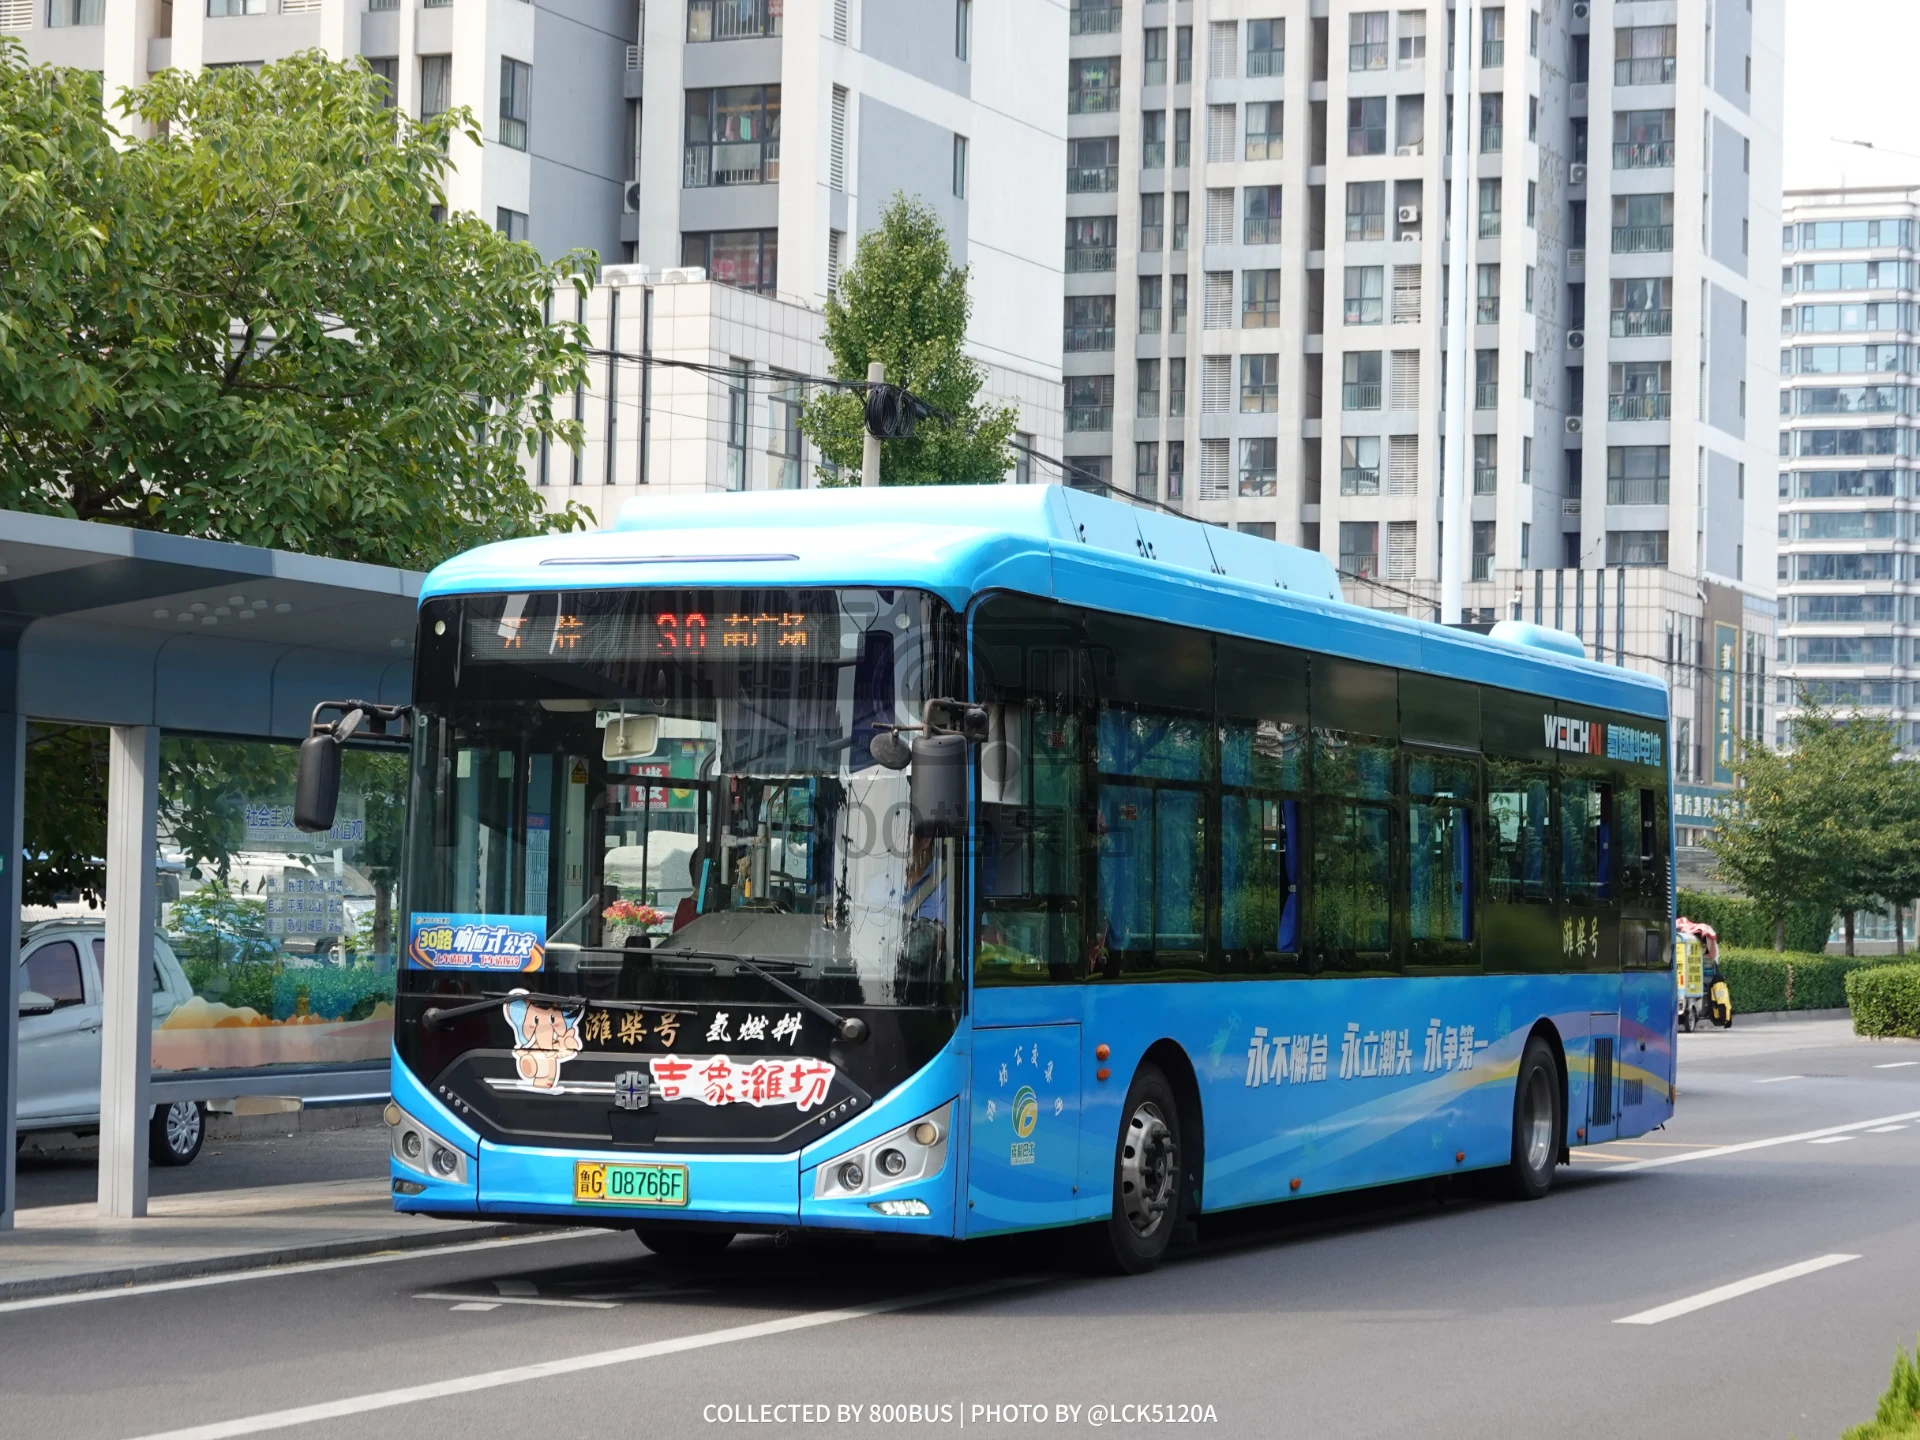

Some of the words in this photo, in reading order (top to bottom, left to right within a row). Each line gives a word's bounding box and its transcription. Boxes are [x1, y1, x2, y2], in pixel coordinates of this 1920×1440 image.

[656, 613, 706, 654] 30
[1543, 714, 1602, 755] WEICHAI
[1606, 723, 1661, 767] 氢燃料电池
[287, 898, 304, 913] 平等
[308, 898, 323, 913] 公正
[327, 898, 342, 913] 法治
[288, 878, 304, 893] 民主
[308, 879, 324, 894] 文明
[287, 918, 303, 933] 敬业
[307, 918, 323, 933] 诚信
[419, 926, 535, 955] 30路响应式公交
[1562, 916, 1599, 959] 潍柴号
[585, 1011, 681, 1048] 潍柴号
[705, 1011, 803, 1046] 氢燃料
[1244, 1026, 1329, 1088] 永不懈怠
[1339, 1022, 1413, 1080] 永立潮头
[1423, 1018, 1490, 1072] 永争第一
[653, 1059, 833, 1108] 吉象潍坊
[580, 1169, 603, 1193] 鲁G
[611, 1170, 683, 1197] 08766F
